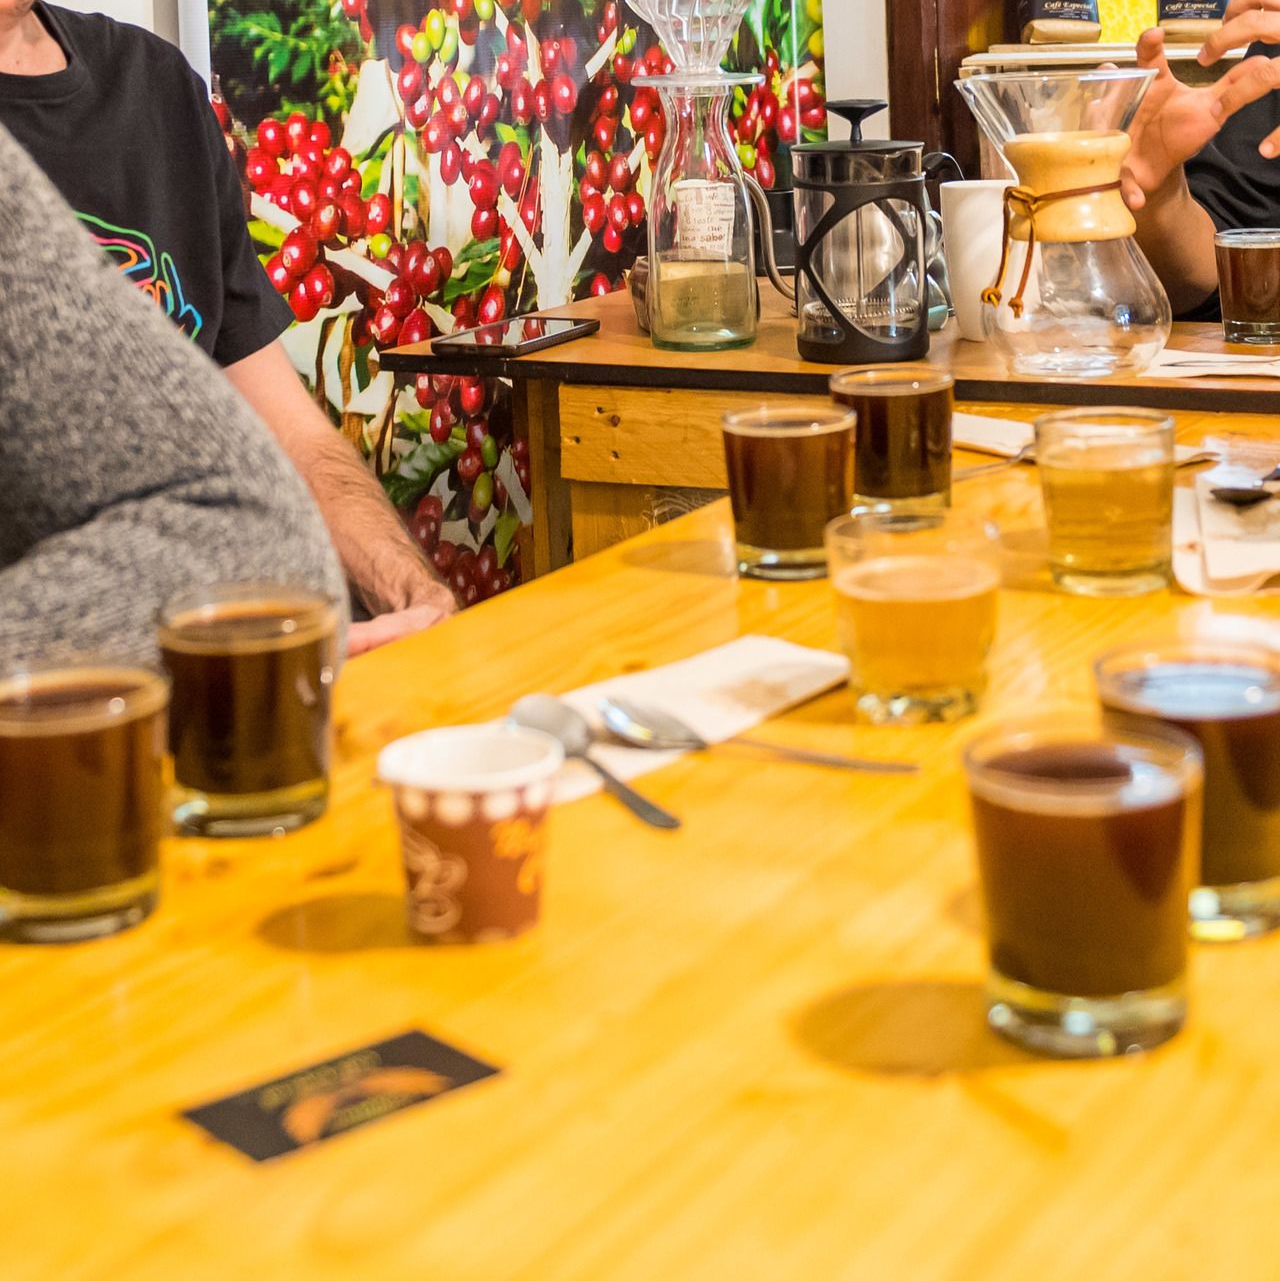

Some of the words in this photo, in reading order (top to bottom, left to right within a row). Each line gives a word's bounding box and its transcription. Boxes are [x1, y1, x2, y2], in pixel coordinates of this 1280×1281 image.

[1044, 0, 1062, 10] Café
[1062, 1, 1093, 11] Especial
[1165, 2, 1183, 12] Café
[1183, 2, 1218, 10] Especial
